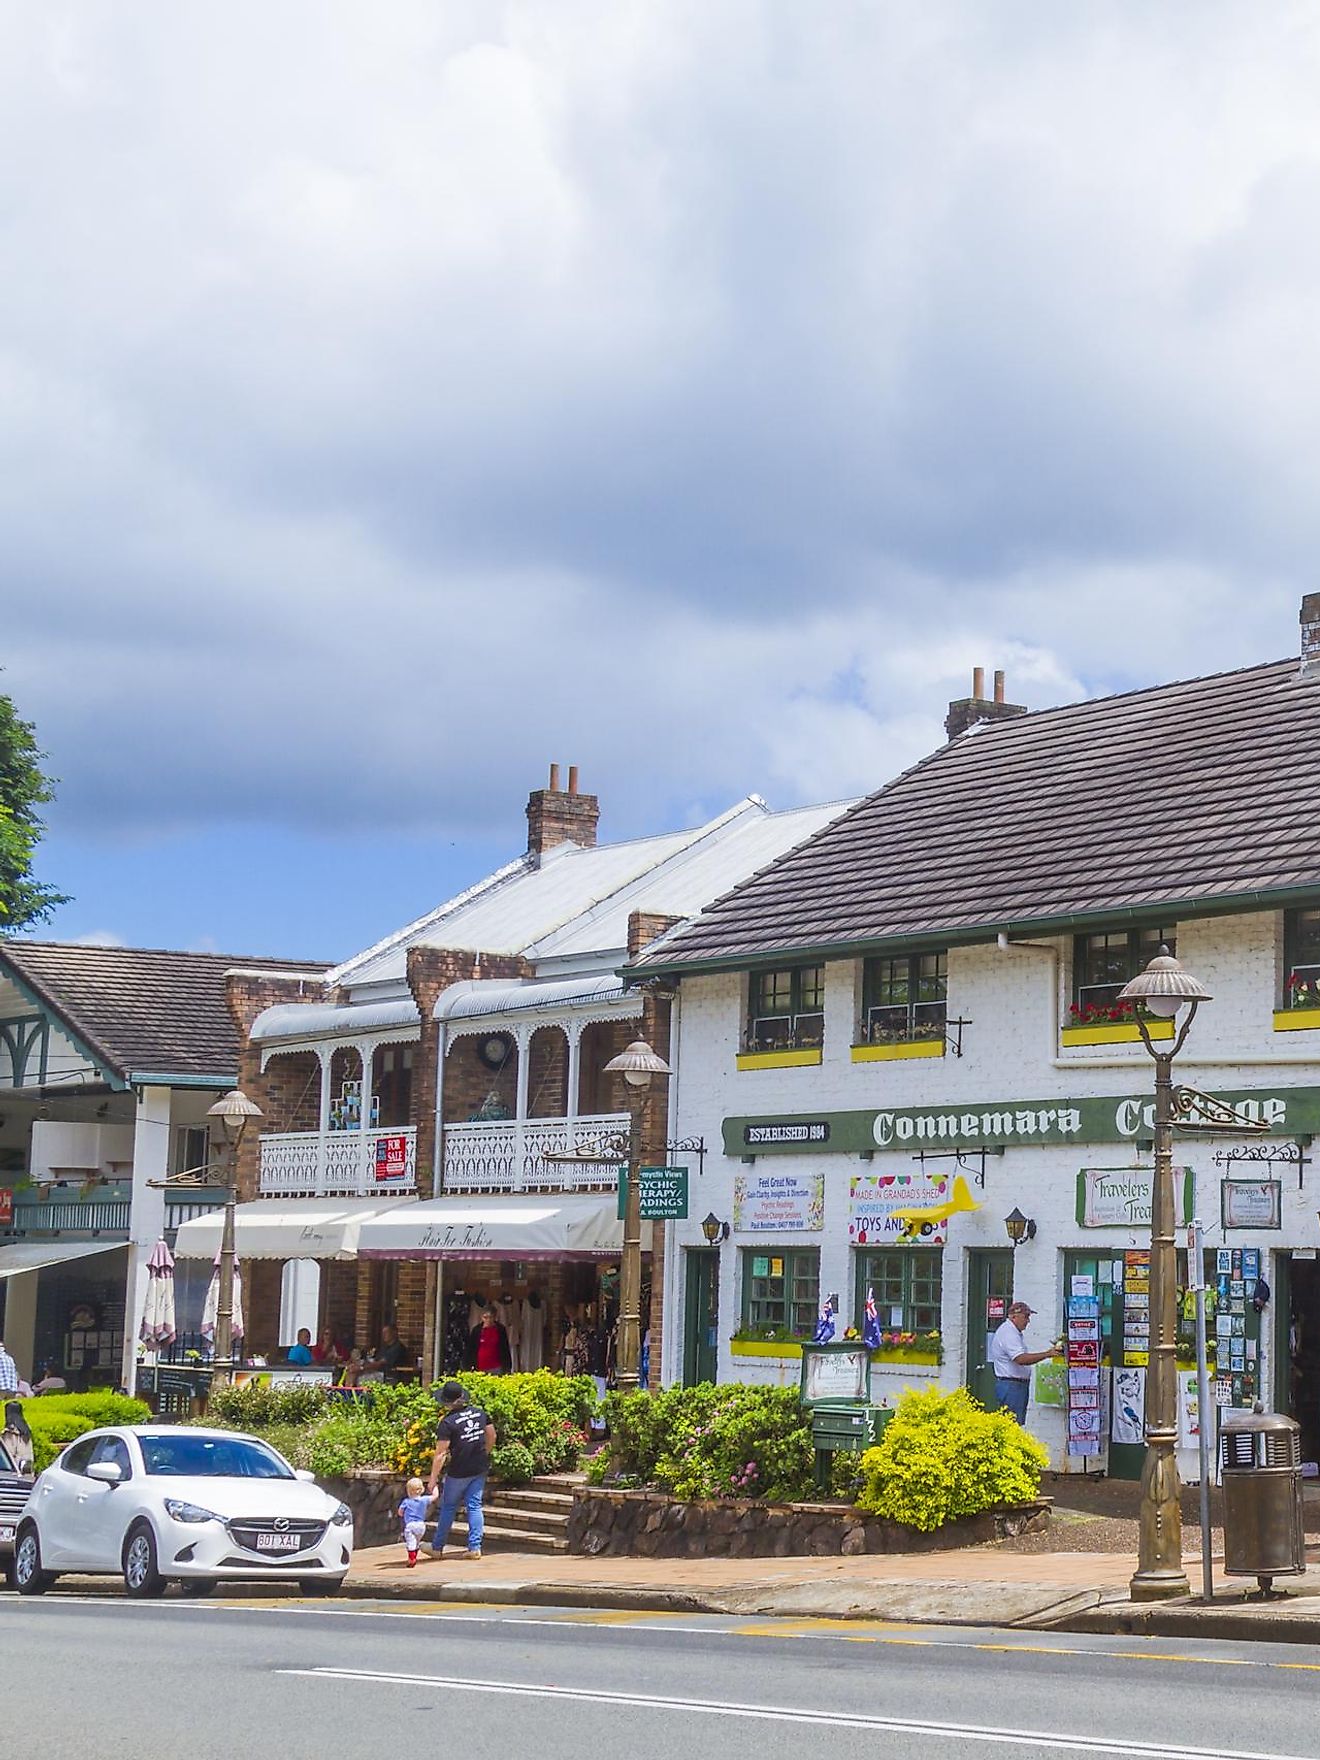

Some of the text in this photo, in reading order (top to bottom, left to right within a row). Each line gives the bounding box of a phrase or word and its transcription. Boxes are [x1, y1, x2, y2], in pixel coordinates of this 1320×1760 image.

[873, 1108, 1082, 1146] Connemara
[749, 1125, 825, 1142] ESTABLISHED 1984
[387, 1139, 401, 1150] FOR
[387, 1150, 402, 1160] SALE
[664, 1170, 682, 1178] Views
[639, 1181, 677, 1189] SYCHIC
[758, 1176, 797, 1188] Feel Great Now
[1094, 1174, 1149, 1198] Travelers
[856, 1190, 873, 1200] MADE
[875, 1190, 882, 1199] IN
[922, 1188, 939, 1199] SHED
[640, 1198, 683, 1207] ADINGS
[857, 1203, 884, 1213] INSPIRED
[885, 1203, 893, 1212] BY
[855, 1217, 904, 1231] TOYS AND
[280, 1535, 298, 1546] XAL
